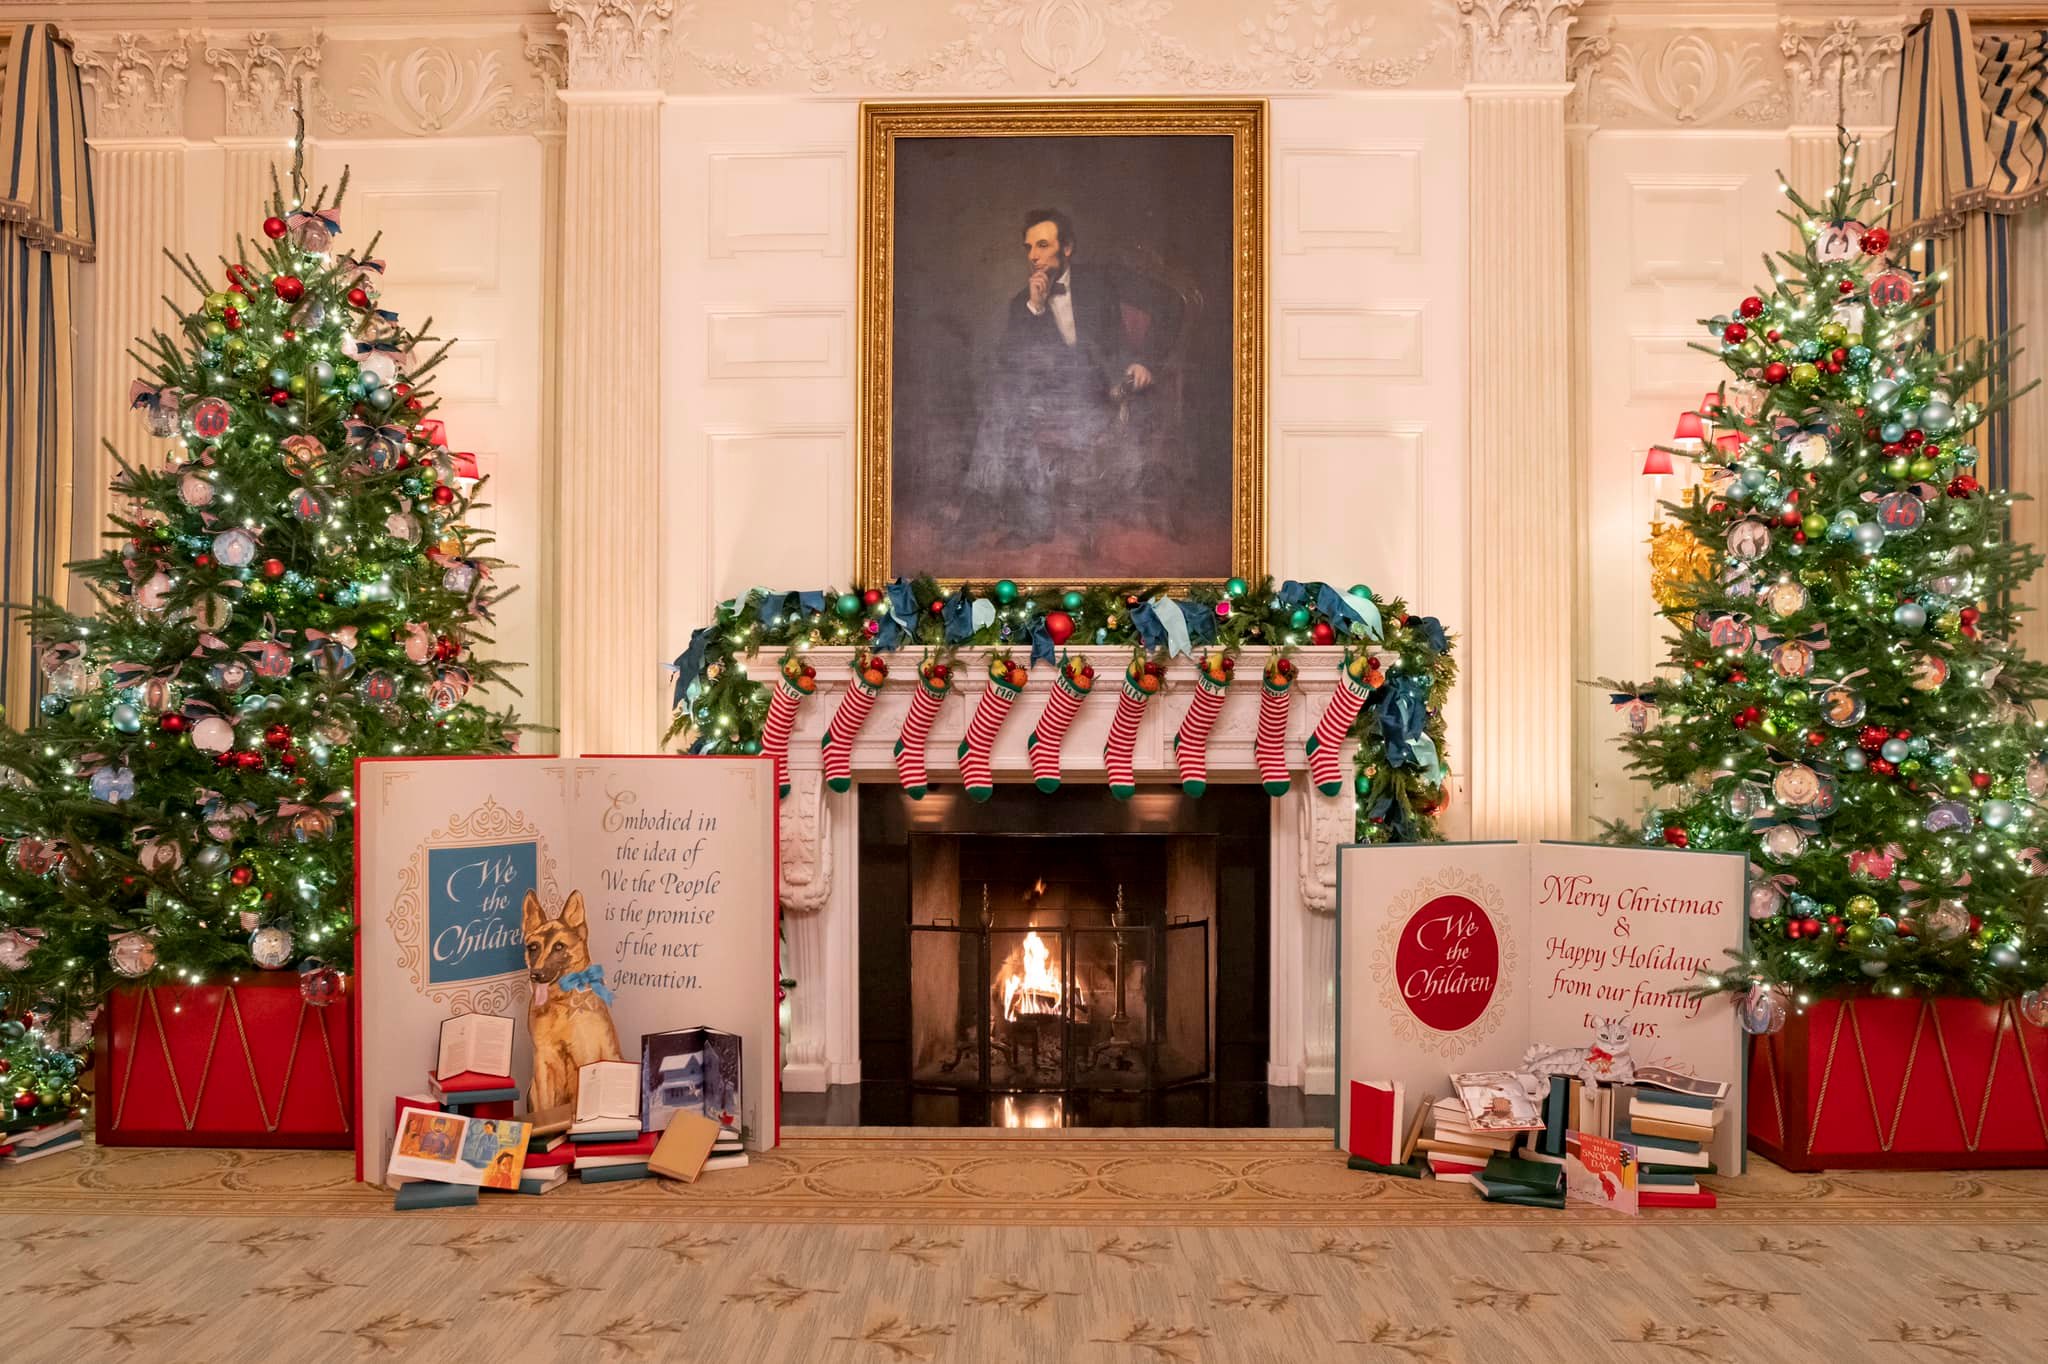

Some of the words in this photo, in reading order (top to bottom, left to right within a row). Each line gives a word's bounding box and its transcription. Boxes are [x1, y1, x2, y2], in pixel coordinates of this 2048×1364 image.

[1874, 281, 1903, 303] 46
[199, 411, 225, 431] 46
[1883, 500, 1917, 527] 46
[368, 676, 393, 700] 46
[602, 783, 693, 833] Embodied
[698, 813, 717, 831] in
[616, 836, 640, 861] the
[643, 840, 677, 862] idea
[682, 837, 707, 870] of
[446, 853, 518, 904] We
[601, 868, 629, 892] We
[631, 868, 656, 893] the
[660, 870, 721, 902] People
[1539, 874, 1612, 917] Merry
[1616, 886, 1724, 917] Christmas
[481, 886, 511, 920] the
[604, 902, 616, 921] is
[619, 898, 644, 922] the
[641, 905, 715, 931] promise
[433, 917, 525, 966] Childre
[1416, 911, 1480, 952] We
[1613, 916, 1631, 938] &
[615, 931, 636, 963] of
[632, 932, 658, 957] the
[661, 941, 704, 958] next
[1446, 937, 1472, 966] the
[1546, 935, 1608, 972] Happy
[1611, 944, 1712, 981] Holidays
[611, 969, 702, 992] generation.
[1403, 965, 1495, 1002] Children
[1547, 968, 1592, 1000] from
[1596, 983, 1632, 1003] our
[1624, 980, 1703, 1019] family
[1591, 1159, 1609, 1172] DAY
